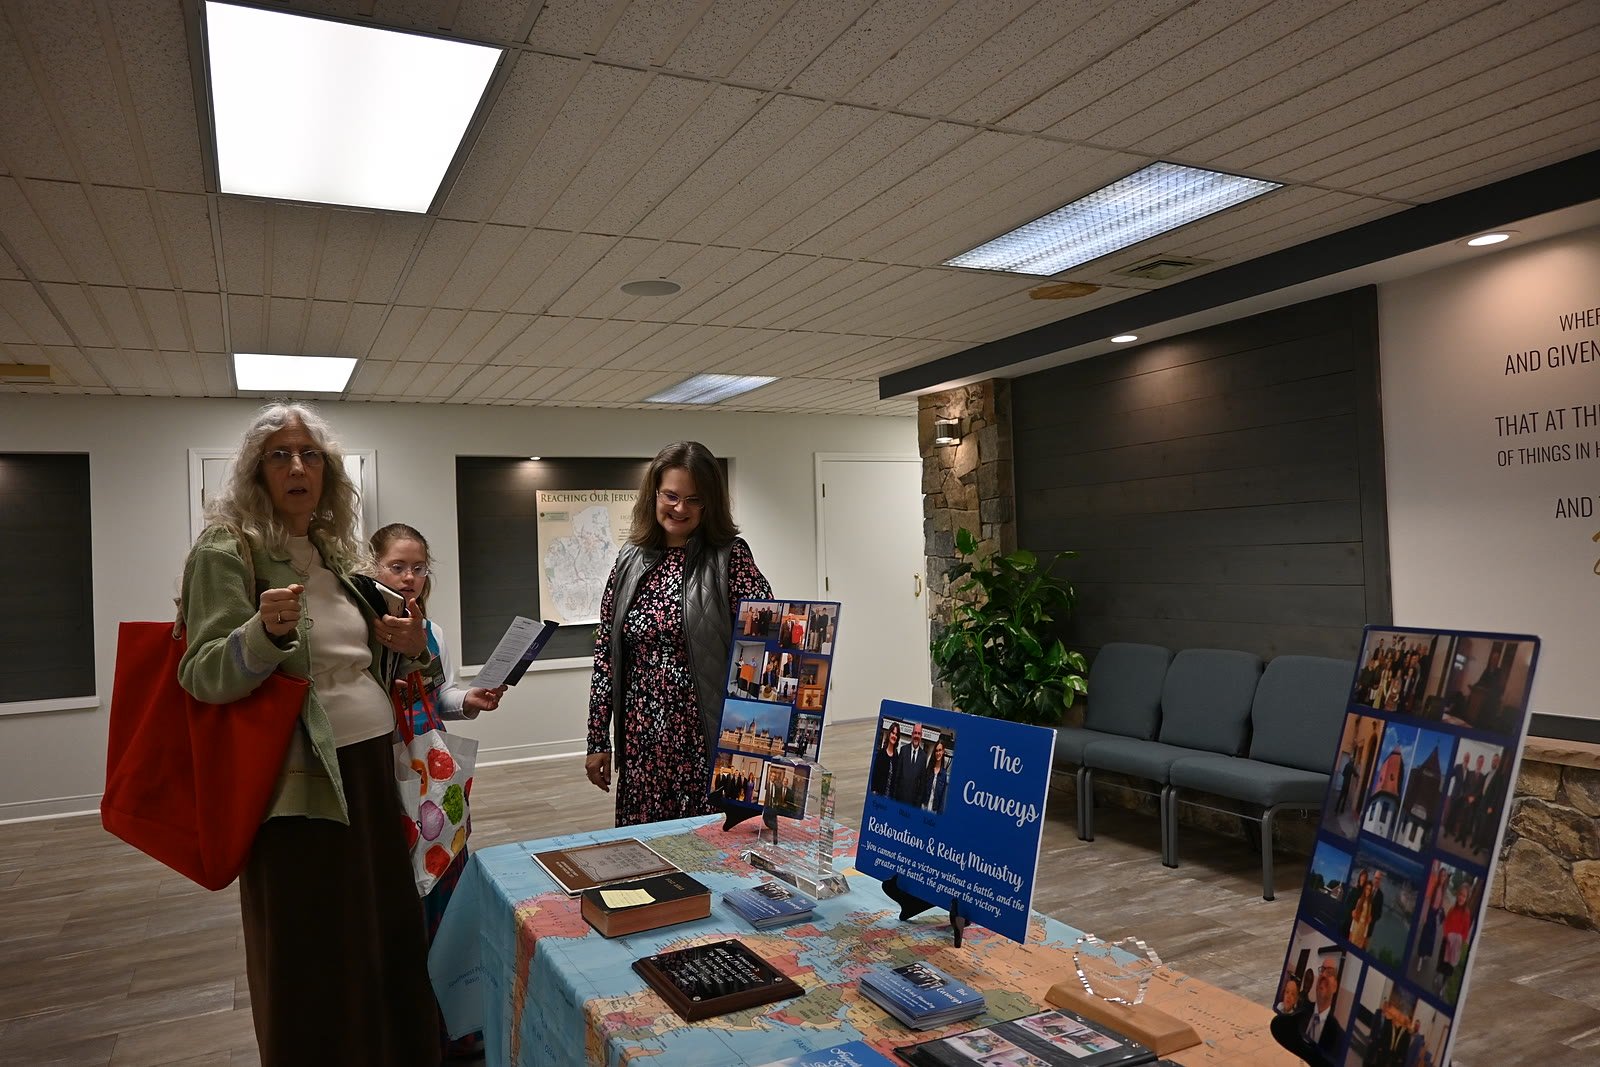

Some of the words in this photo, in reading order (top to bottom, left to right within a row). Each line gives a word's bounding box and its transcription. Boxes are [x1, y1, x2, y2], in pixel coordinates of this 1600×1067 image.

[1505, 350, 1541, 375] AND
[1495, 411, 1539, 437] THAT
[1545, 408, 1566, 432] AT
[1571, 404, 1600, 428] TH
[1497, 449, 1514, 467] OF
[1518, 443, 1571, 465] THINGS
[1576, 441, 1590, 460] IN
[541, 493, 587, 503] REACHING
[589, 493, 609, 503] OUR
[1555, 496, 1593, 519] AND
[990, 745, 1024, 774] The
[963, 780, 1039, 828] Carneys
[868, 816, 925, 851] Restoration
[926, 837, 935, 856] &
[937, 842, 967, 871] Relief
[968, 851, 1024, 892] Ministry
[874, 857, 897, 871] greater
[897, 864, 906, 876] the
[906, 868, 925, 885] battle,
[926, 877, 936, 888] the
[936, 883, 961, 898] greater
[962, 892, 973, 904] the
[975, 899, 1002, 918] victory.
[877, 846, 897, 860] cannot
[897, 852, 912, 866] have
[918, 862, 940, 880] victory
[941, 871, 966, 888] without
[967, 883, 972, 891] a
[973, 882, 995, 901] battle,
[996, 894, 1013, 906] and
[1012, 899, 1025, 912] the
